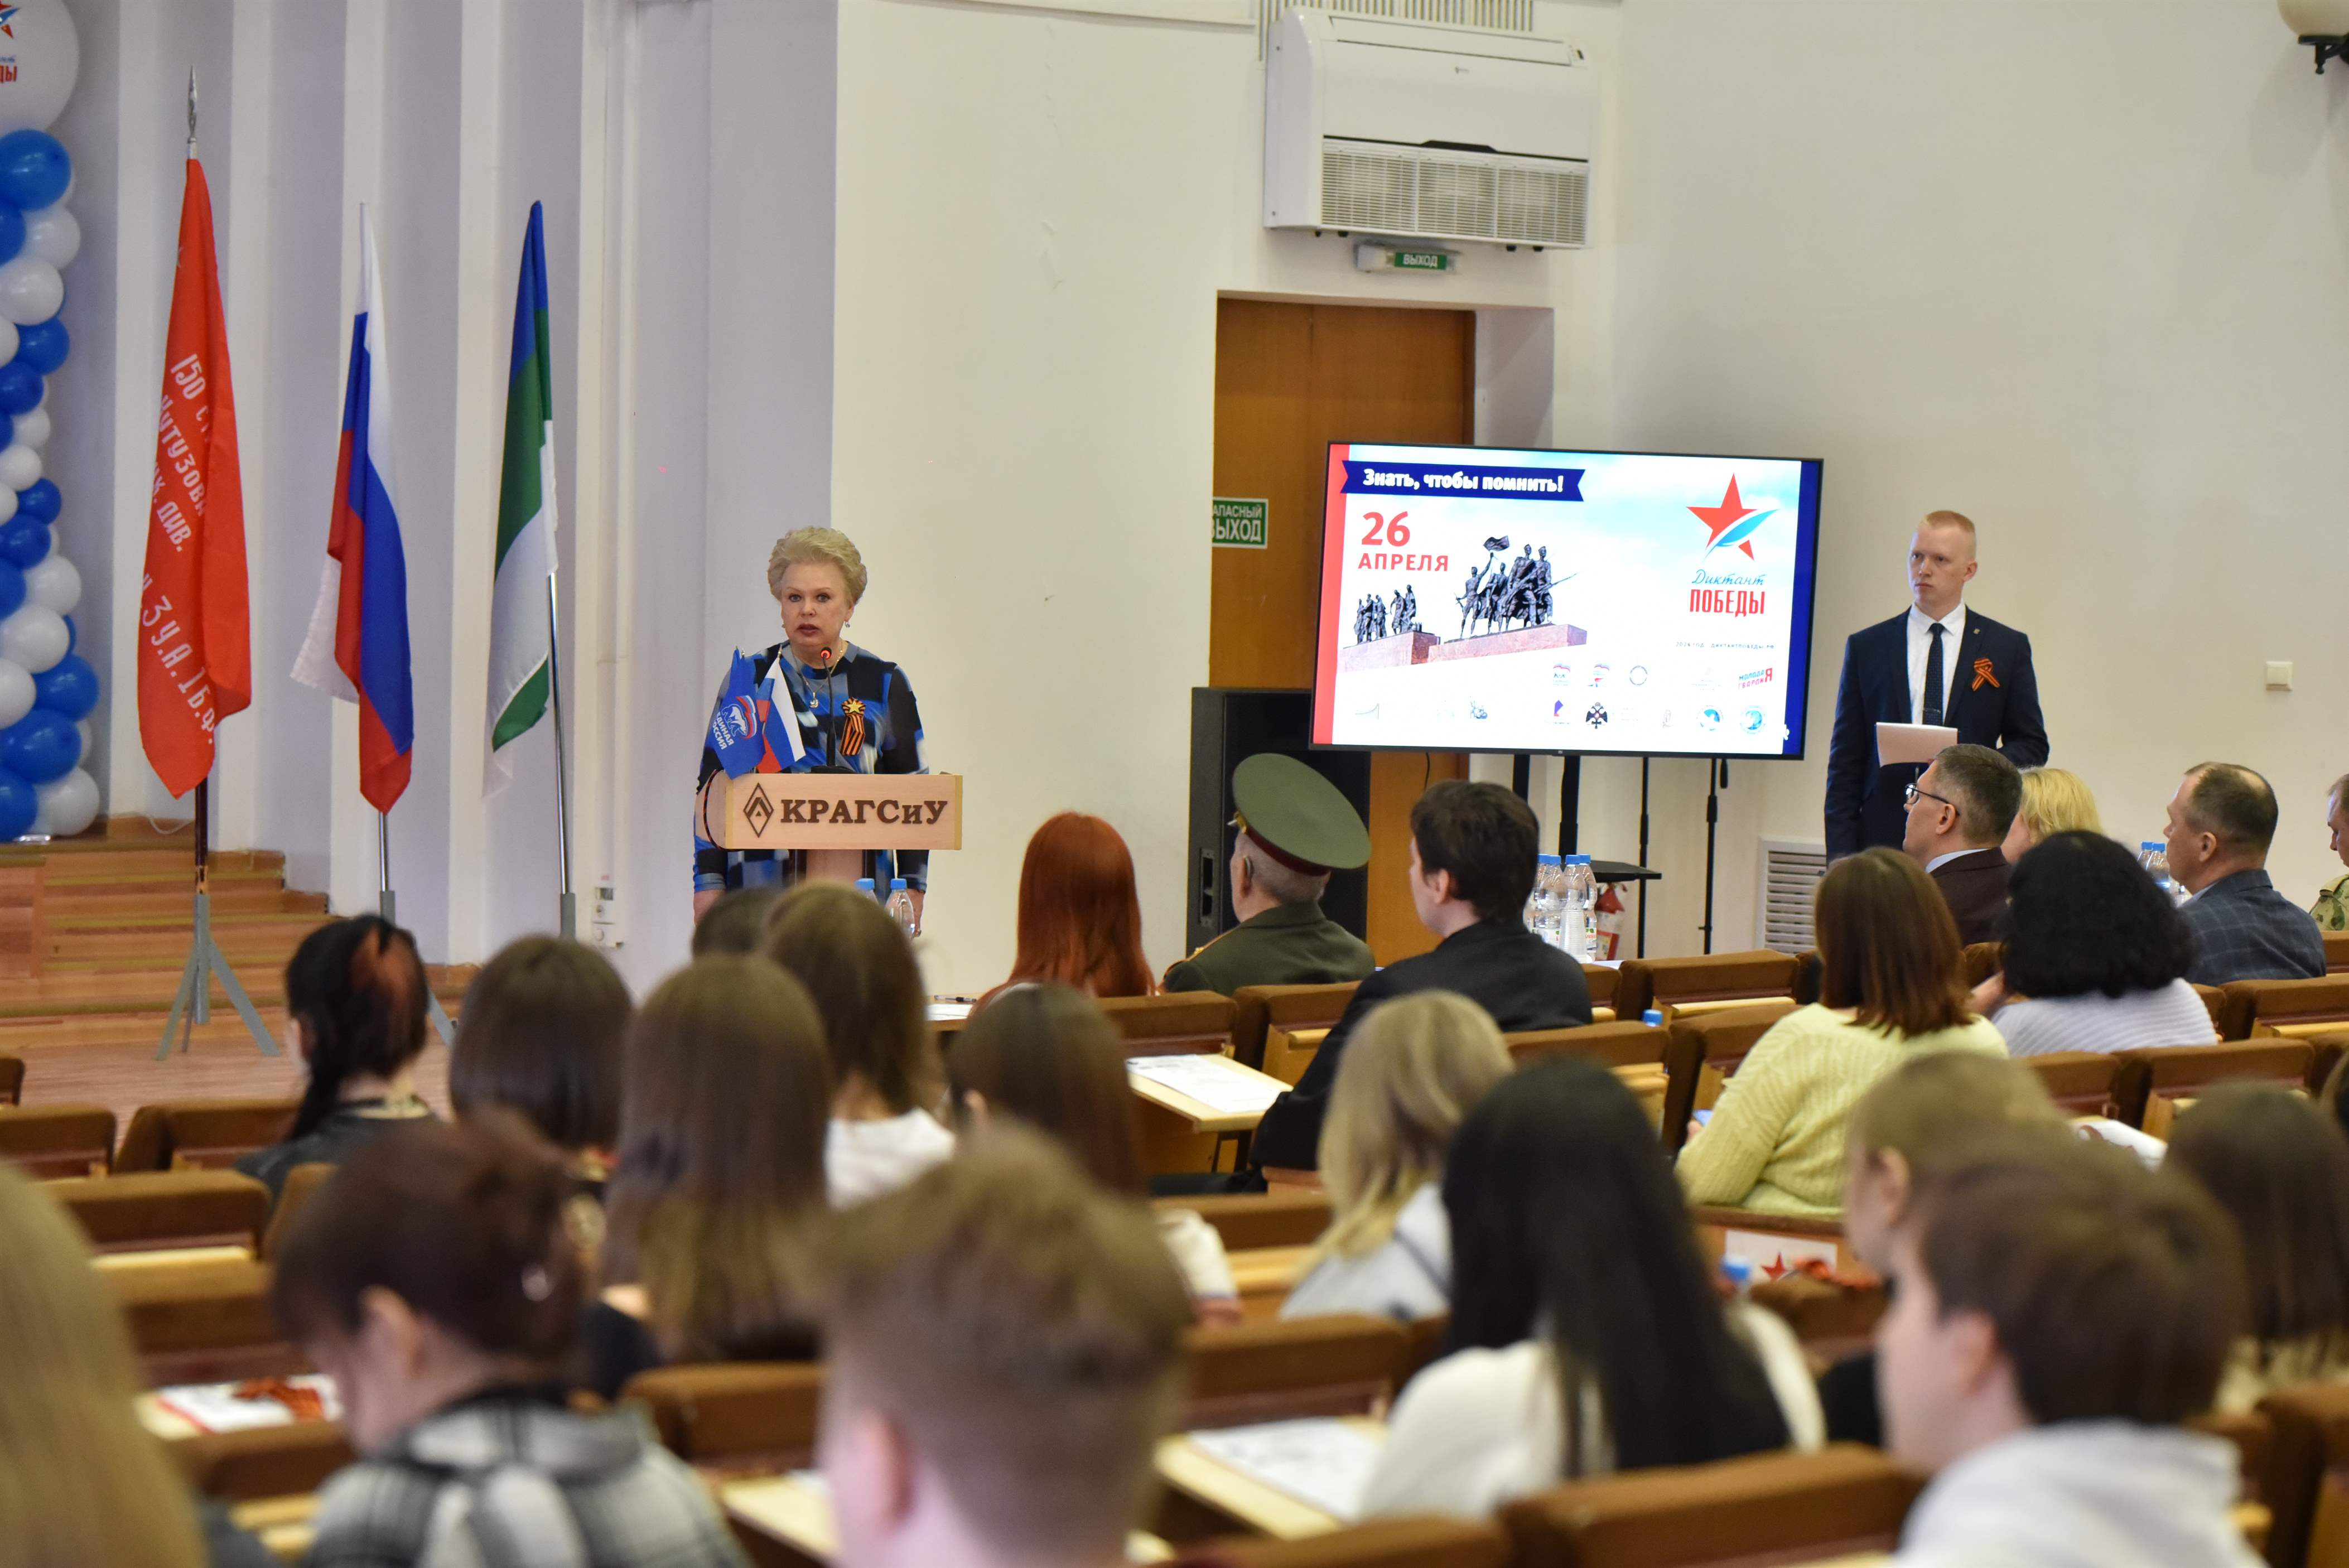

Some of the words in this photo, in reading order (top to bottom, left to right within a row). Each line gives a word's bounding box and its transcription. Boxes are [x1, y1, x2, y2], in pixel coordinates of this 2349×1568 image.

[1402, 254, 1438, 268] ВЫХОД
[171, 353, 206, 400] 150
[1363, 469, 1420, 490] Знать,
[1424, 471, 1478, 490] чтобы
[1482, 475, 1564, 493] помнить!
[1213, 504, 1262, 519] АПАСНЫЙ
[1361, 511, 1411, 547] 26
[1358, 553, 1449, 572] АПРЕЛЯ
[1691, 569, 1767, 586] Диктант
[1690, 589, 1766, 617] ПОБЕДЫ
[712, 720, 727, 750] ОССИЯ
[780, 799, 948, 825] КРАГСиУ
